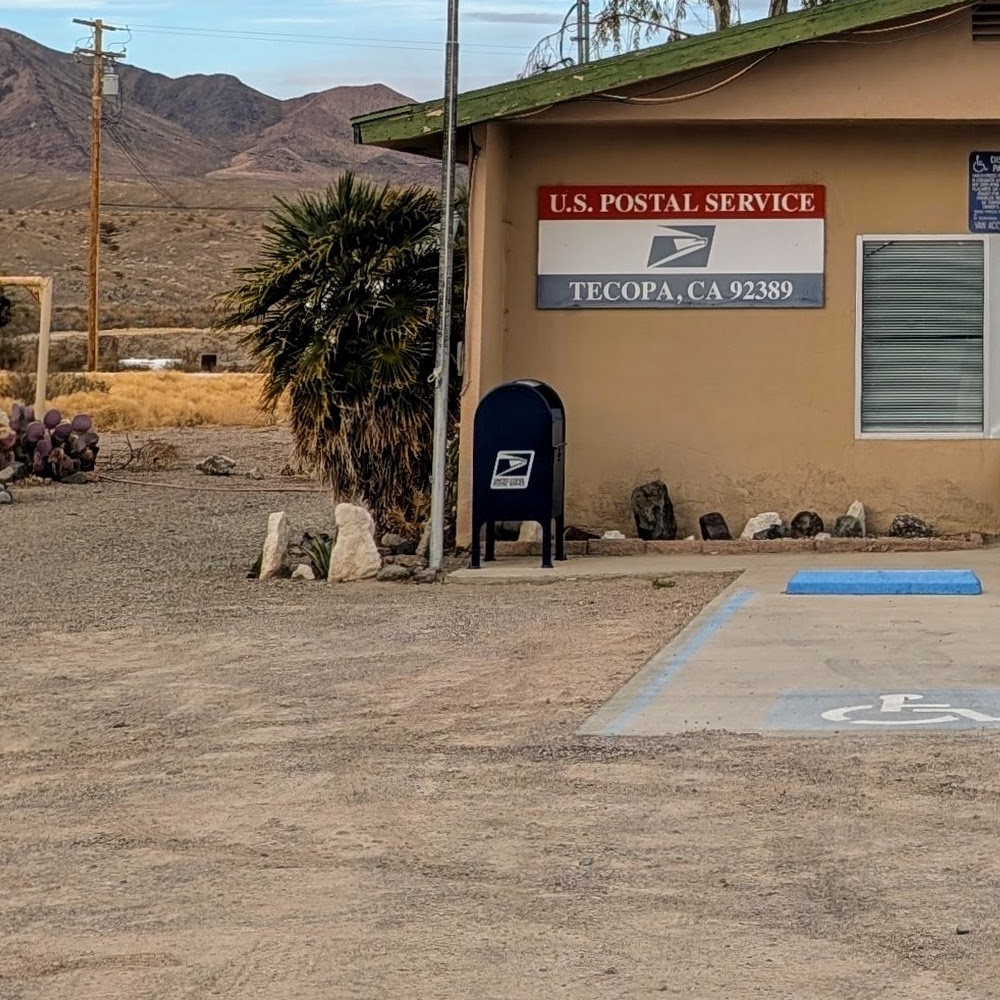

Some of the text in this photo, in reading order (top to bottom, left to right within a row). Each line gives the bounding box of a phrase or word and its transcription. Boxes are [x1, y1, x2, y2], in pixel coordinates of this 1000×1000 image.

[550, 192, 816, 213] U.S. POSTAL SERVICE
[974, 221, 987, 230] VAN
[569, 280, 793, 304] TECOPA, CA 92389
